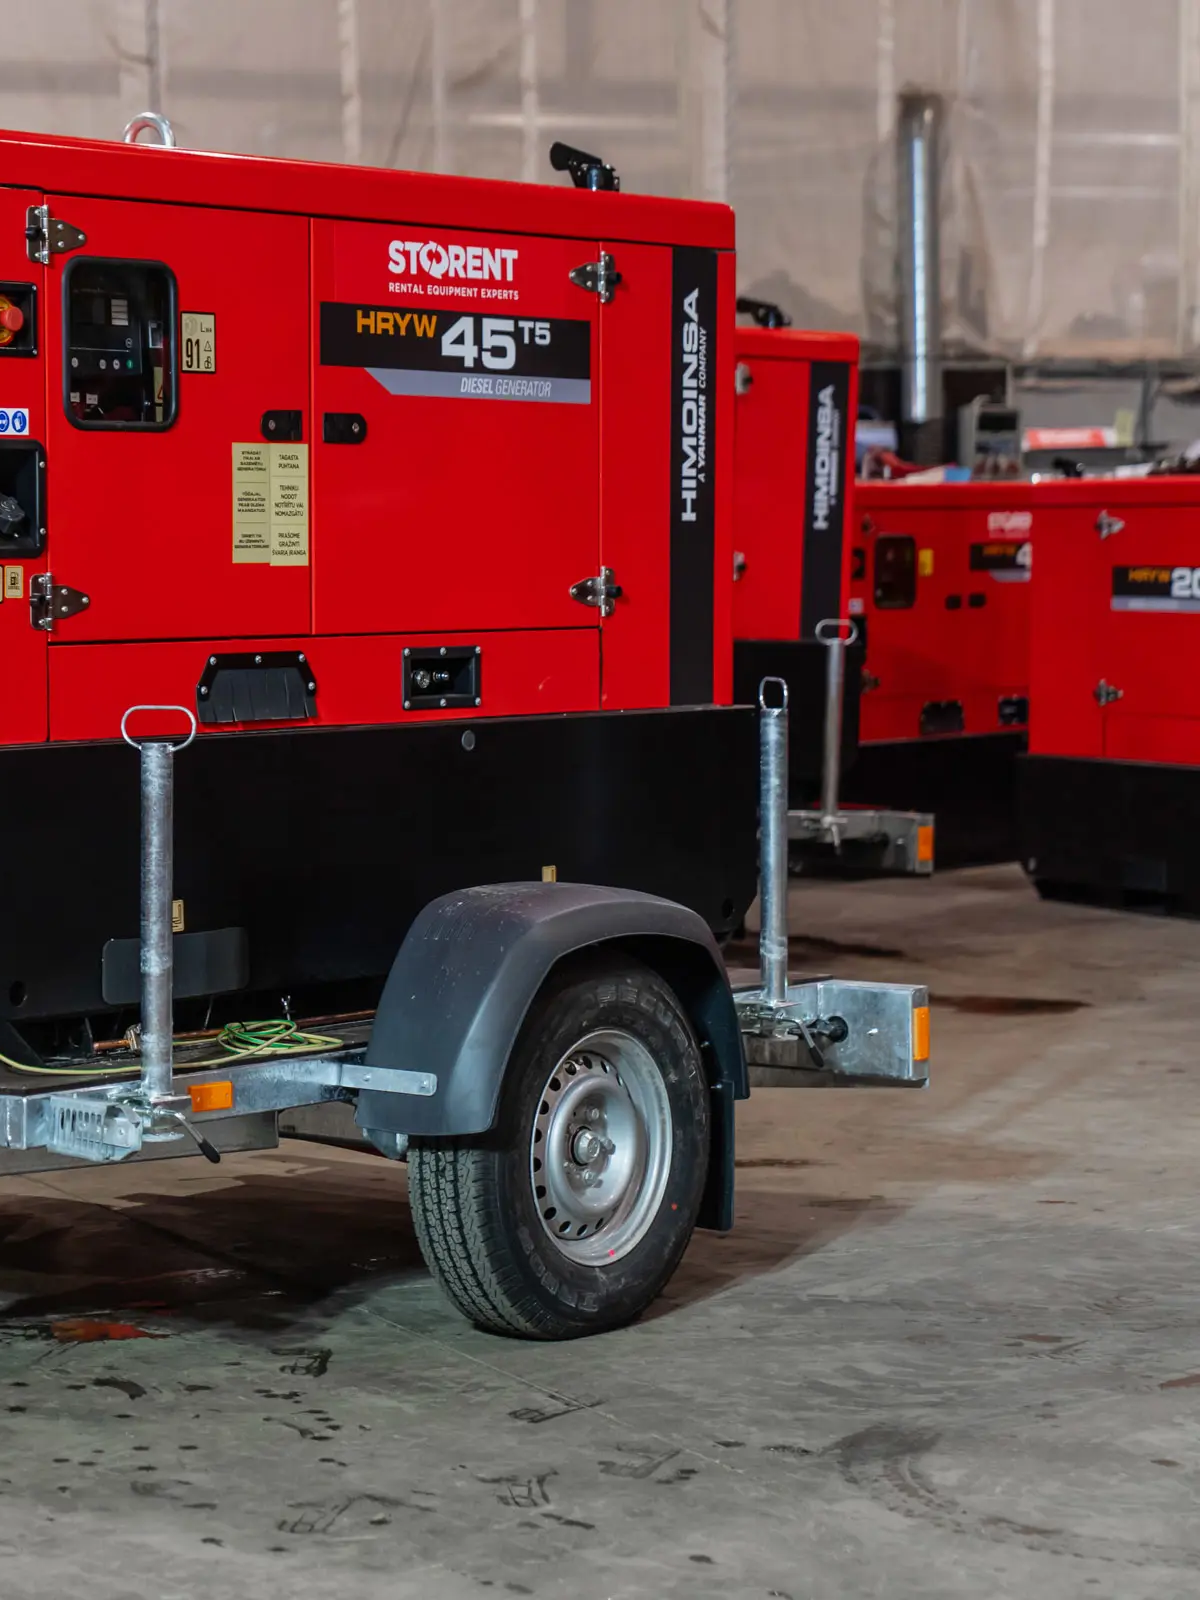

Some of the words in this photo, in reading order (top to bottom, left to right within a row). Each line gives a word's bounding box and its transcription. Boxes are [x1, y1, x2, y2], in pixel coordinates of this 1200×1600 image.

[388, 240, 518, 281] STORENT
[389, 282, 424, 294] RENTAL
[427, 285, 478, 298] EQUIPMENT
[481, 288, 519, 300] EXPERTS
[186, 338, 200, 368] 91
[356, 310, 437, 338] HRYW
[441, 316, 516, 370] 45
[518, 321, 551, 345] T5
[699, 327, 707, 389] COMPANY
[460, 377, 493, 395] DIESEL
[495, 379, 552, 398] GENERATOR
[681, 288, 699, 522] HIMOINSA
[698, 395, 707, 469] YANMAR
